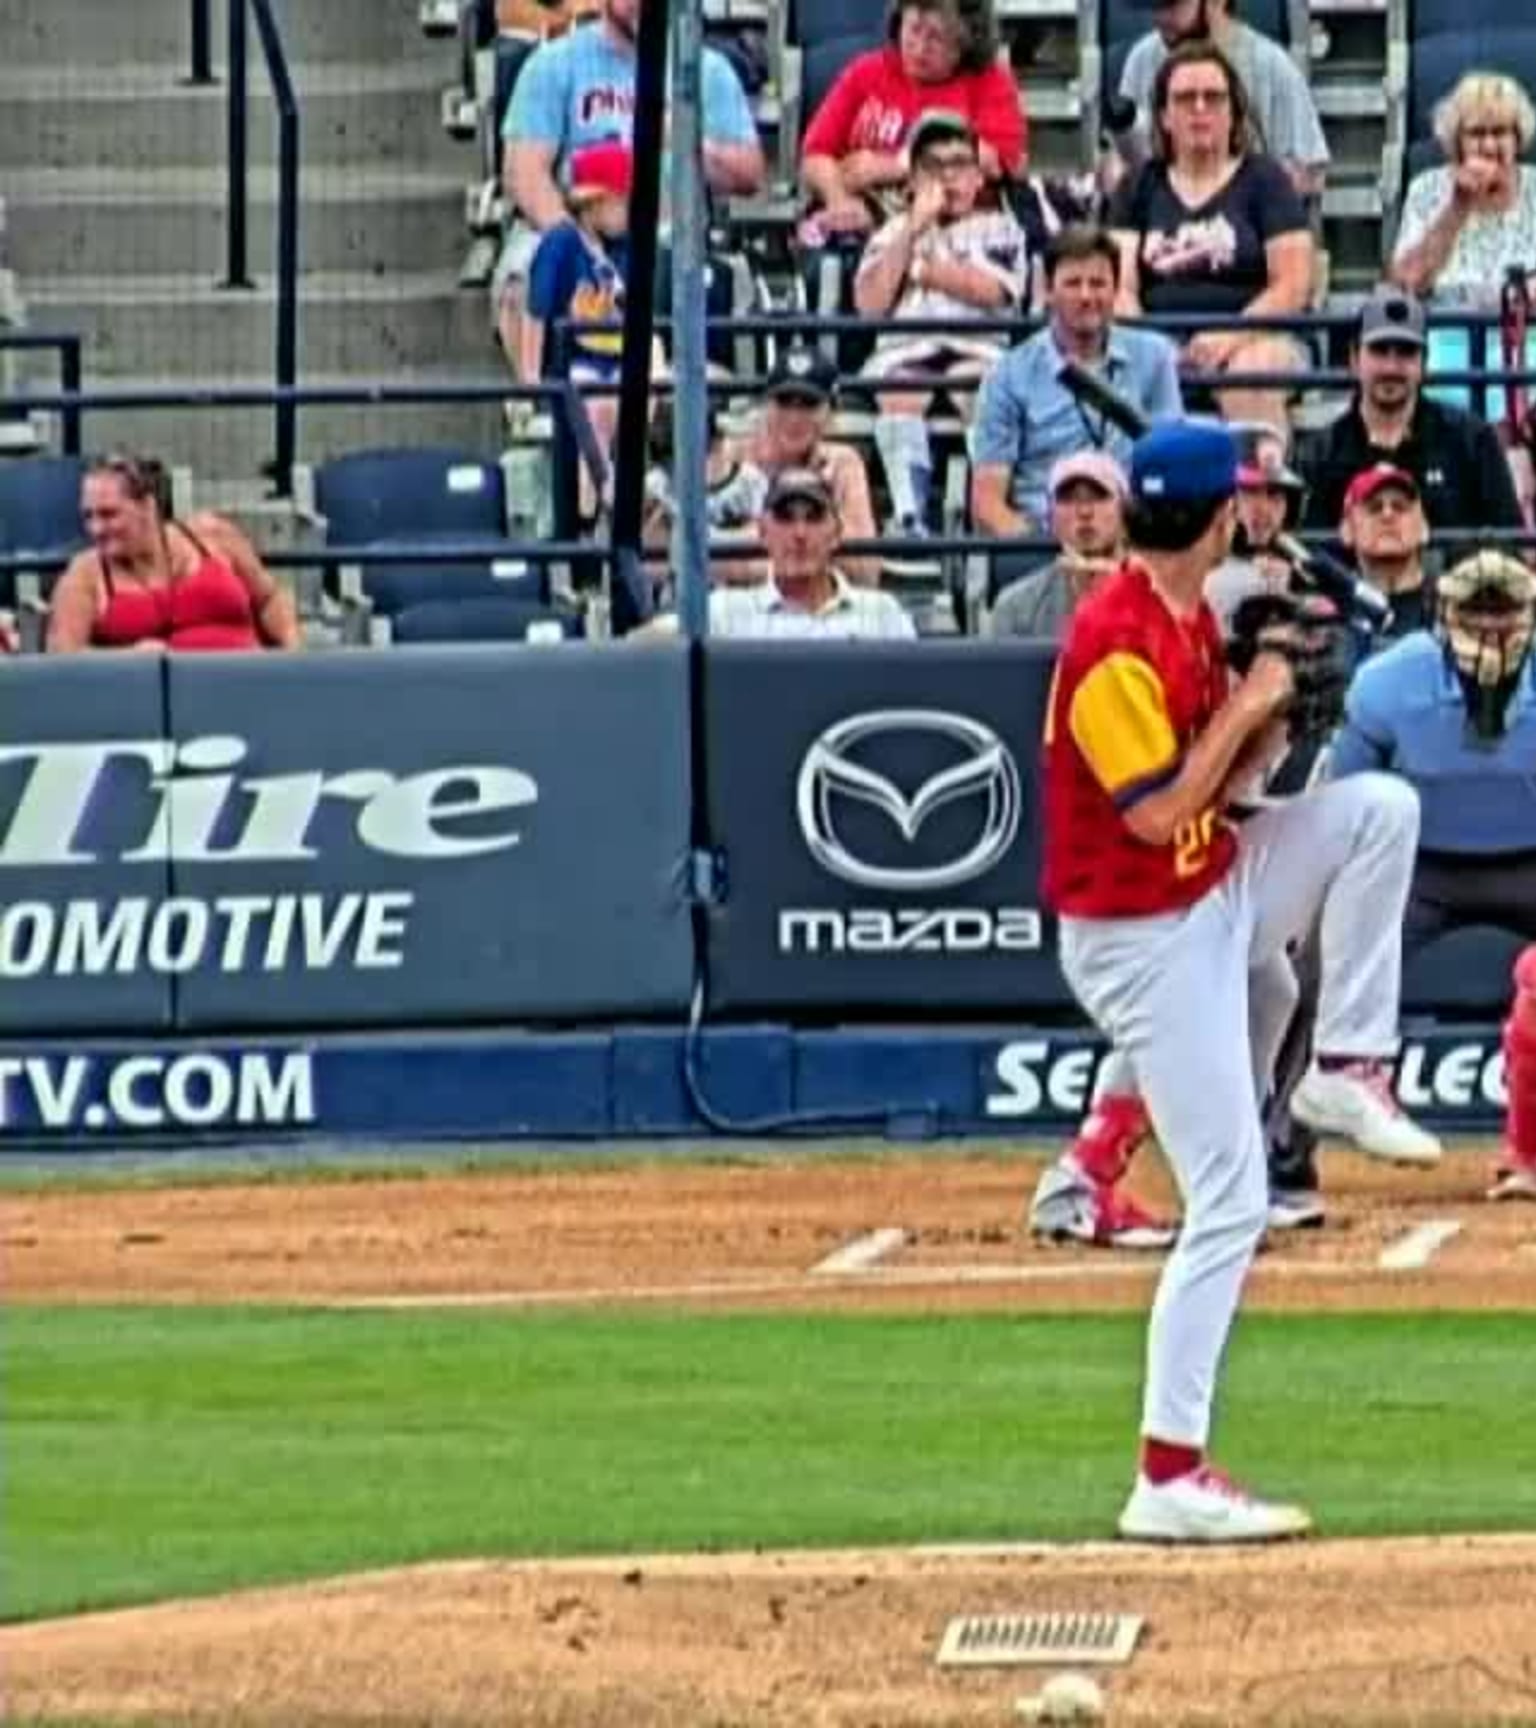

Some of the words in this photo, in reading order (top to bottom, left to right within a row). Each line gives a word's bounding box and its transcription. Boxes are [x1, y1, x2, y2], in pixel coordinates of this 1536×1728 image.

[0, 735, 538, 864] Tire
[0, 893, 414, 977] OMOTIVE
[779, 909, 1041, 951] mazda
